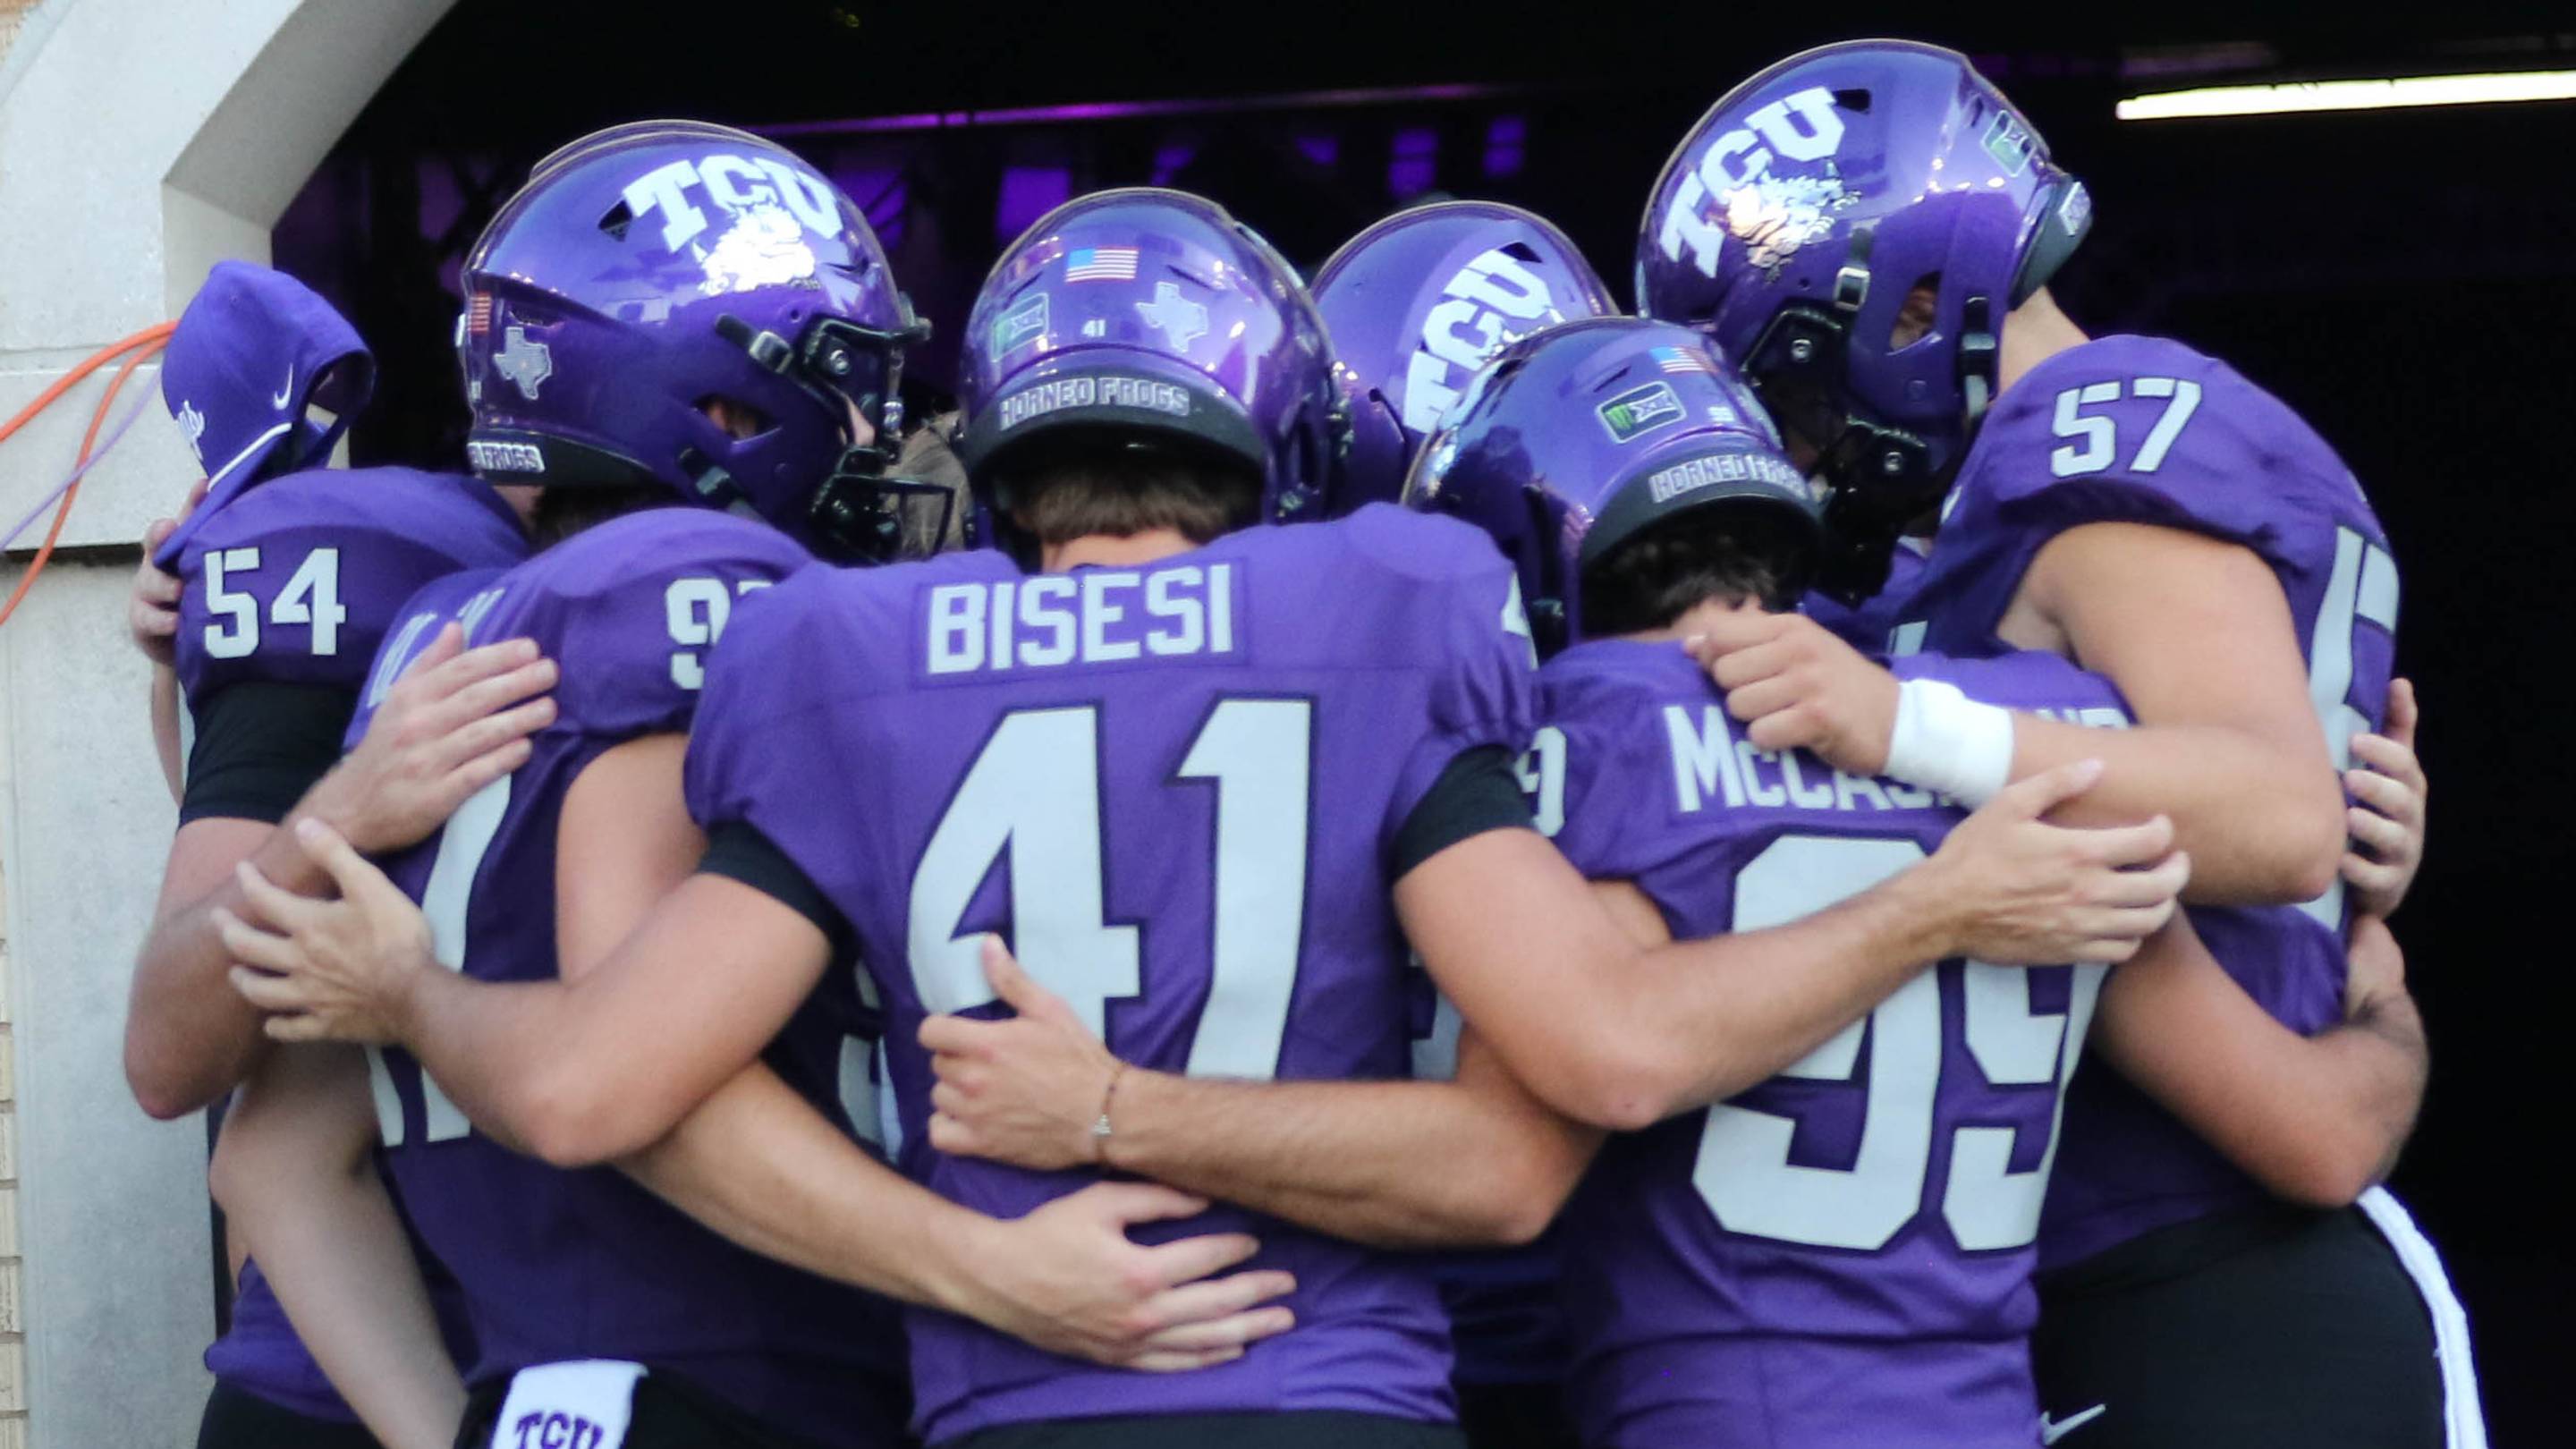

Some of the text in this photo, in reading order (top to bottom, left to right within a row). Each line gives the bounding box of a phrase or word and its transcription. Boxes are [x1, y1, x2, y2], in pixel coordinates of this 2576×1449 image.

[623, 154, 844, 253] TCU
[1660, 87, 1845, 277] TCU
[1081, 319, 1106, 337] 41
[1402, 242, 1554, 434] TCU
[1000, 377, 1190, 430] HORNED FROGS
[2051, 377, 2201, 478] 57
[204, 547, 345, 659] 54
[665, 578, 774, 691] 9
[926, 564, 1233, 674] BISESI
[908, 699, 1311, 1080] 41
[1692, 835, 2111, 1250] 99
[515, 1410, 605, 1449] TCU
